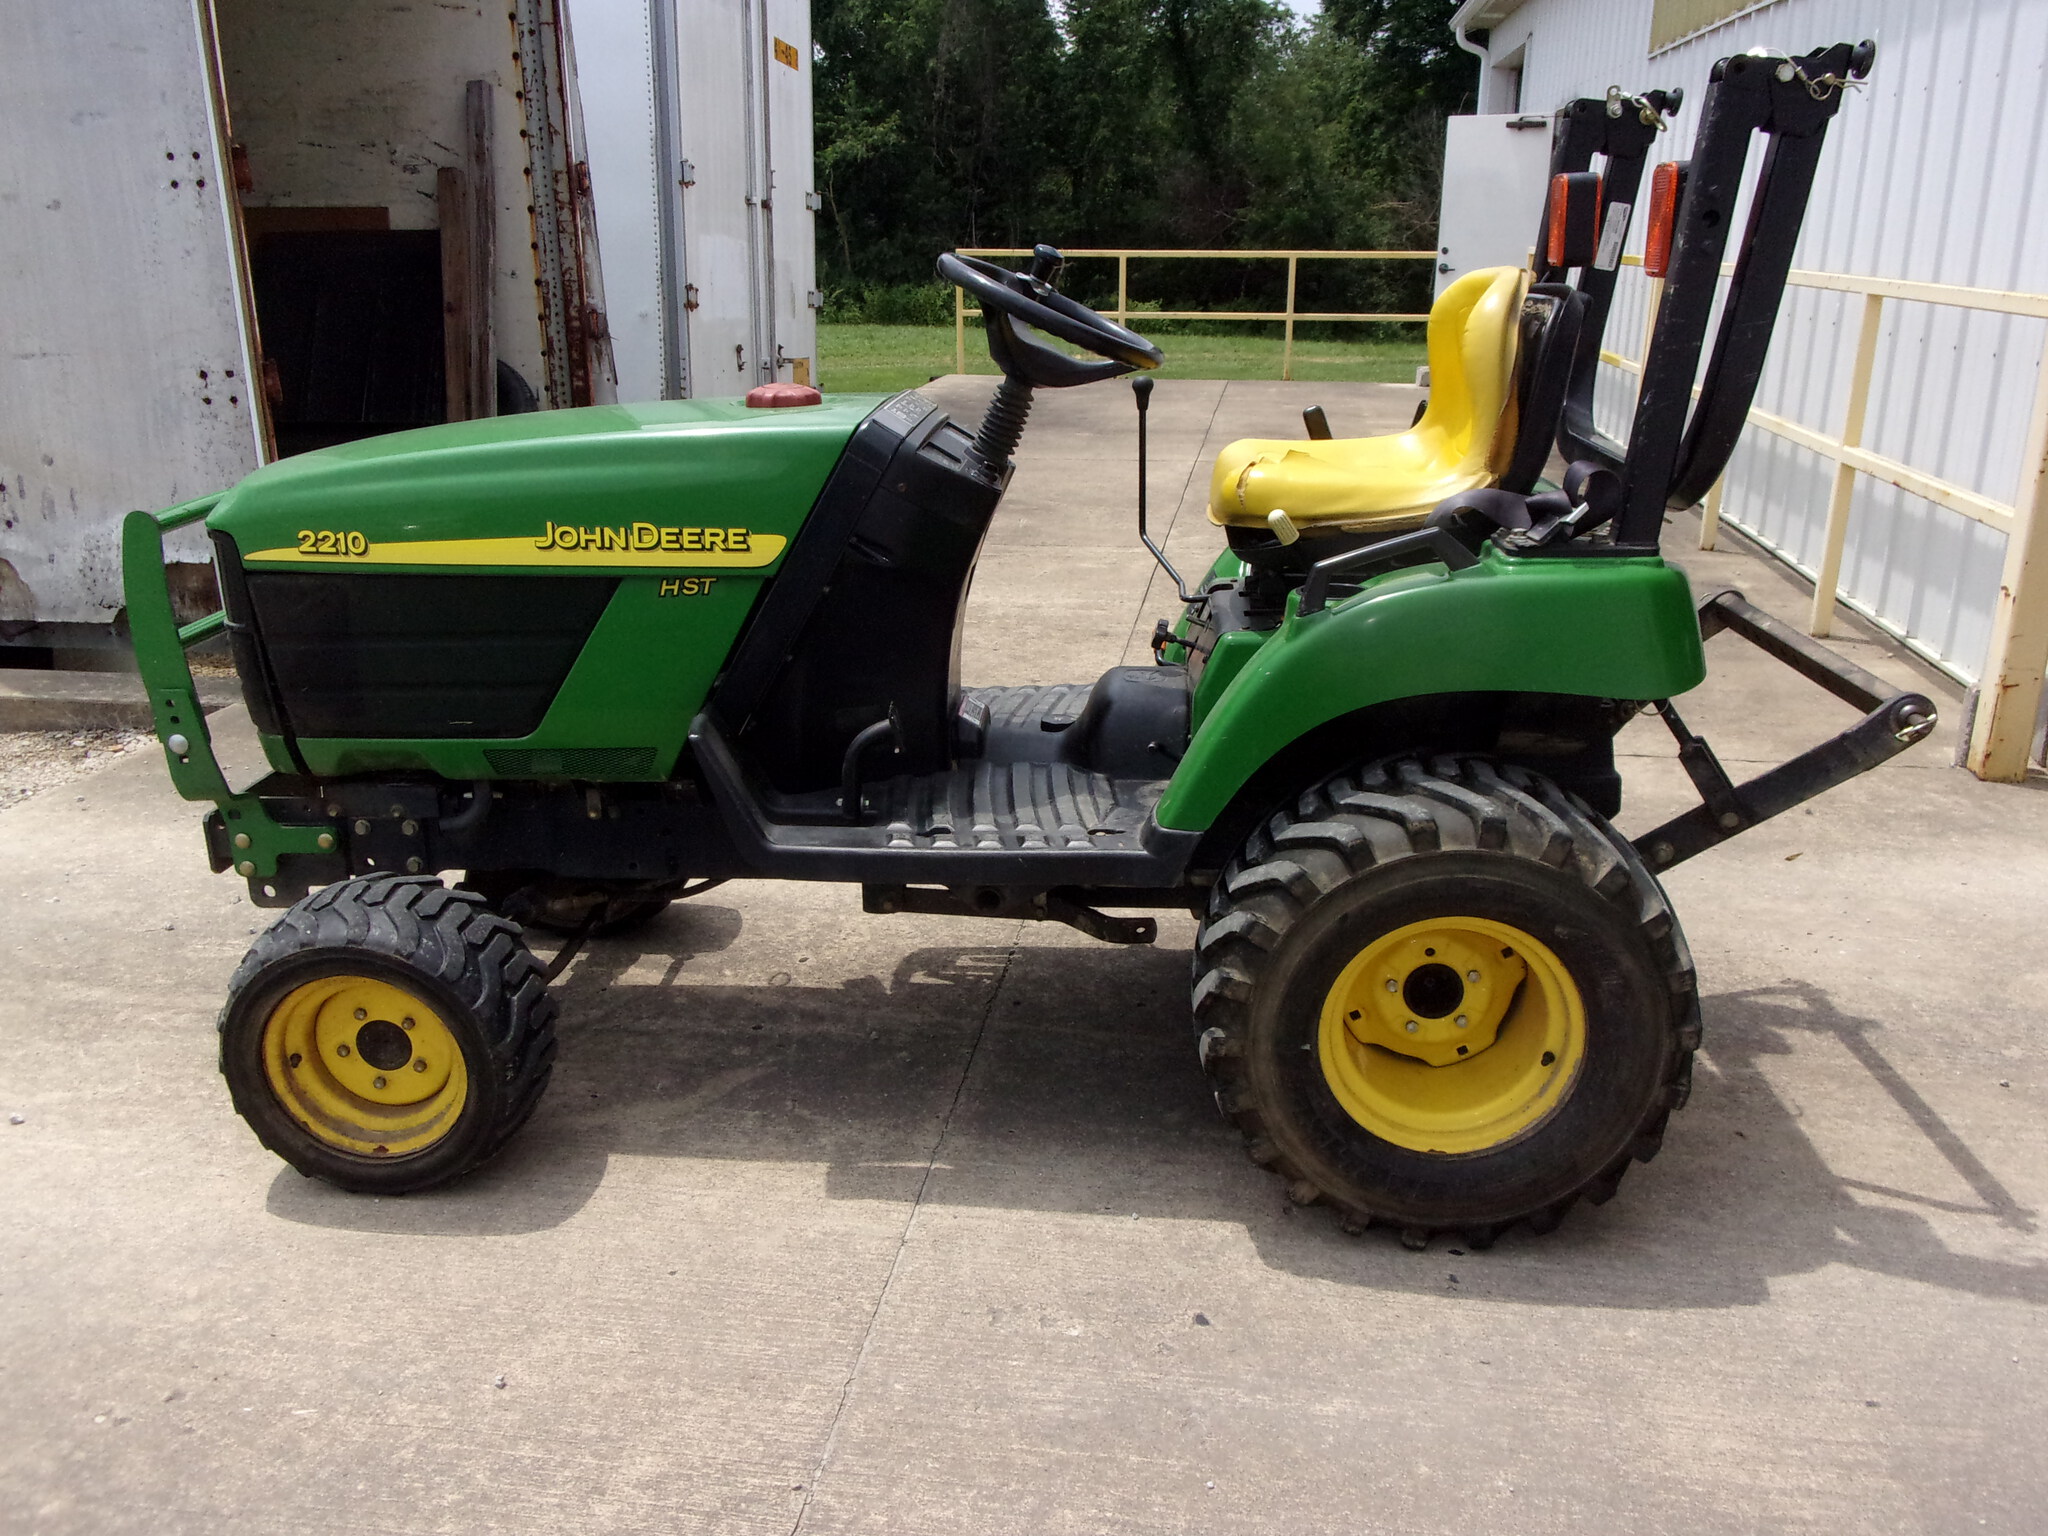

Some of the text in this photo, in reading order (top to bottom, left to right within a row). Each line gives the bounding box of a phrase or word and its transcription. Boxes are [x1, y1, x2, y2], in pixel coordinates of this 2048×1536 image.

[297, 529, 368, 556] 2210
[535, 521, 751, 553] JOHN DEERE
[659, 577, 717, 597] HST
